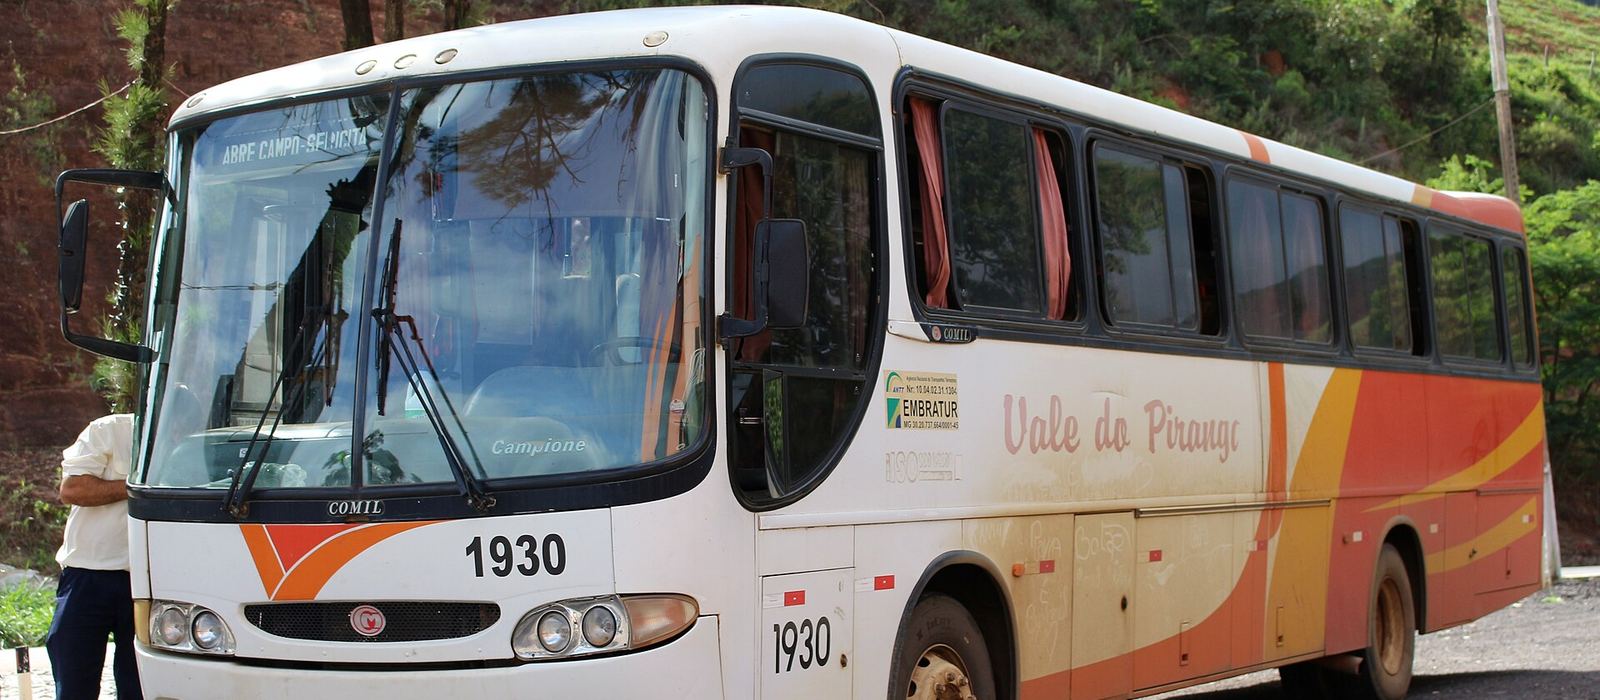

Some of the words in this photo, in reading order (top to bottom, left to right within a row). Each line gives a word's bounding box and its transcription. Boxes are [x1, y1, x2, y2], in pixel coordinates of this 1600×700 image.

[222, 142, 256, 165] ABRE
[943, 328, 969, 341] COMIL
[903, 399, 958, 418] EMBRATUR
[1003, 394, 1081, 455] Vale
[1094, 397, 1131, 452] do
[491, 438, 586, 457] Campione
[329, 500, 382, 515] COMIL
[465, 533, 566, 577] 1930
[773, 616, 830, 674] 1930
